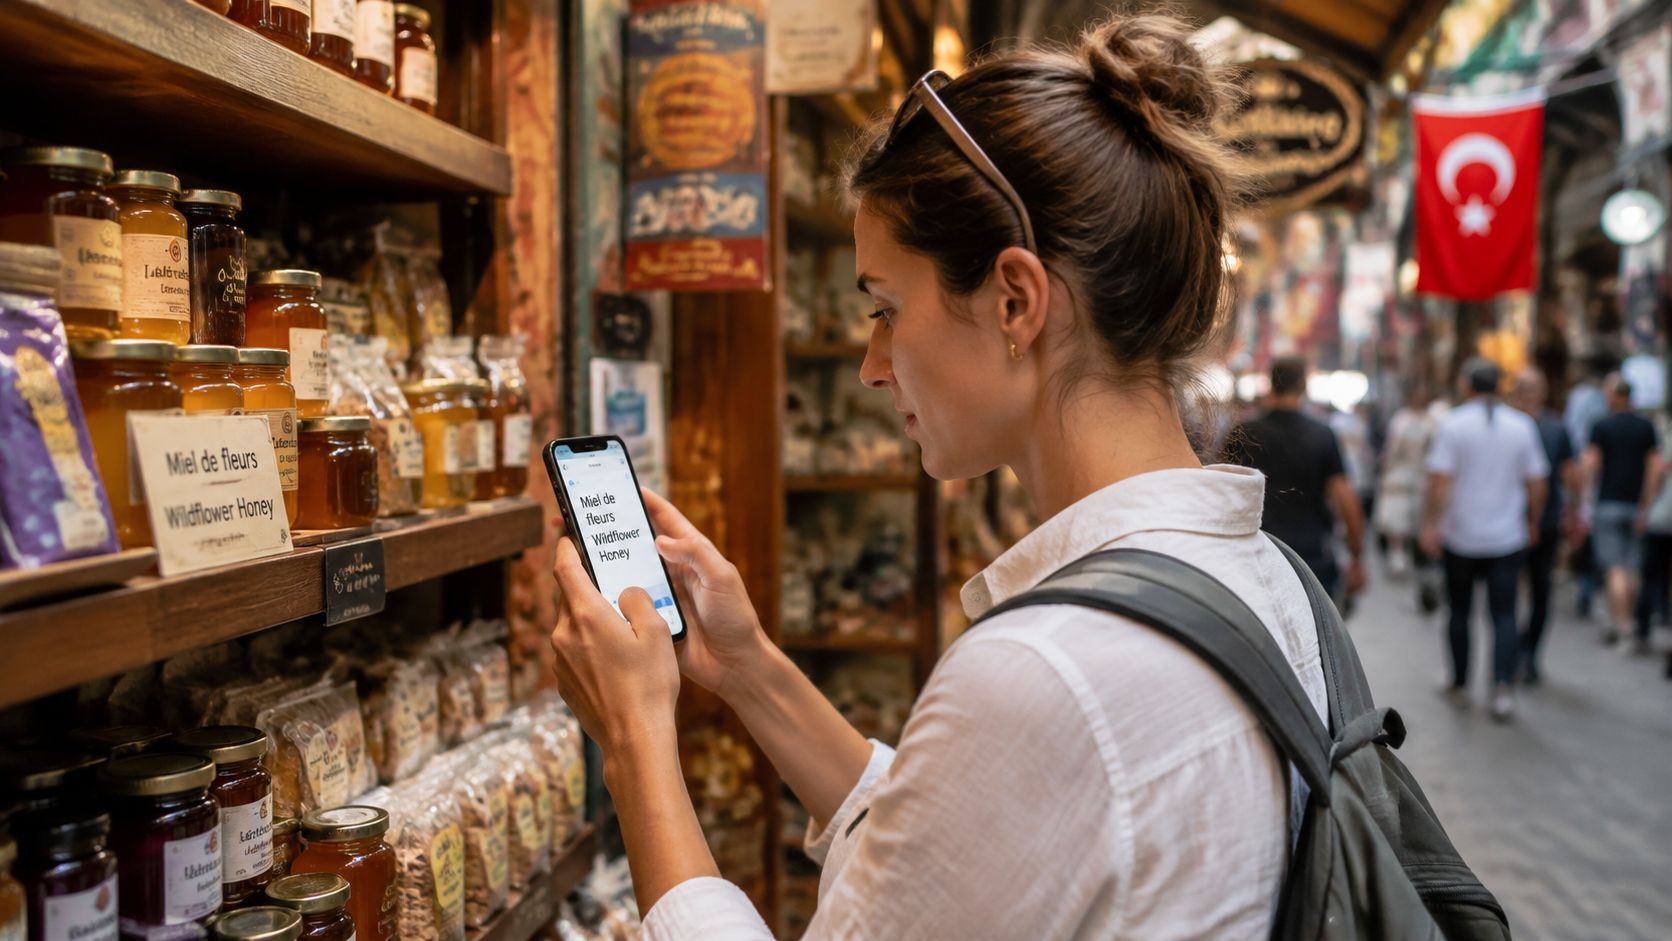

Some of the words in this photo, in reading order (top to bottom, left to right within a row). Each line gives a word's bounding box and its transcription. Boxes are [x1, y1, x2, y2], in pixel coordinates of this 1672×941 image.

[165, 450, 198, 476] Miel
[201, 449, 218, 472] de
[221, 447, 258, 470] fleurs
[580, 493, 601, 509] Miel
[603, 492, 616, 505] de
[164, 501, 234, 529] Wildflower
[237, 497, 274, 520] Honey
[586, 511, 616, 526] fleurs
[599, 548, 630, 562] Honey
